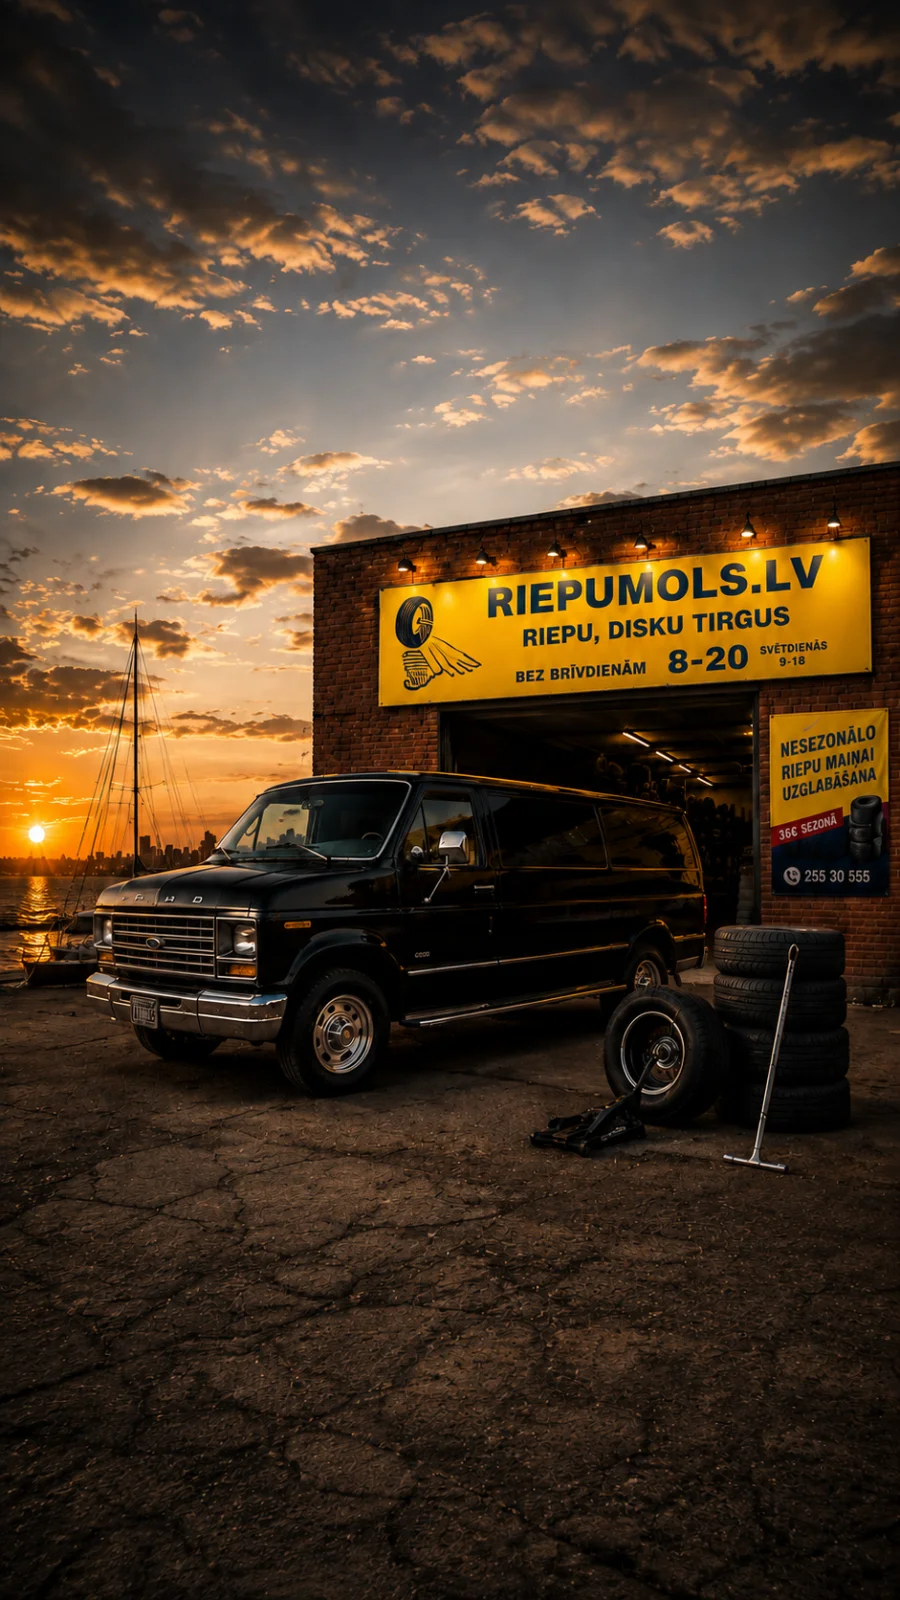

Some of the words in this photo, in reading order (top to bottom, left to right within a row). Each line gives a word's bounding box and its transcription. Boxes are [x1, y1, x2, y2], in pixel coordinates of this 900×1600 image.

[487, 555, 824, 618] RIEPUMOLS.LV
[523, 623, 600, 647] RIEPU,
[608, 615, 684, 640] DISKU
[692, 606, 790, 633] TIRGUS
[760, 639, 828, 655] SVĒTDIENĀS
[779, 656, 806, 667] 9-18
[515, 669, 545, 683] BEZ
[550, 659, 647, 681] BRĪVDIENĀM
[667, 644, 749, 674] 8-20
[780, 725, 876, 757] NESEZONĀLO
[781, 758, 821, 780] RIEPU
[825, 747, 875, 768] MAIŅAI
[778, 826, 798, 841] 36€
[800, 813, 837, 835] SEZONĀ
[804, 870, 826, 883] 255
[829, 870, 845, 883] 30
[848, 870, 870, 883] 555
